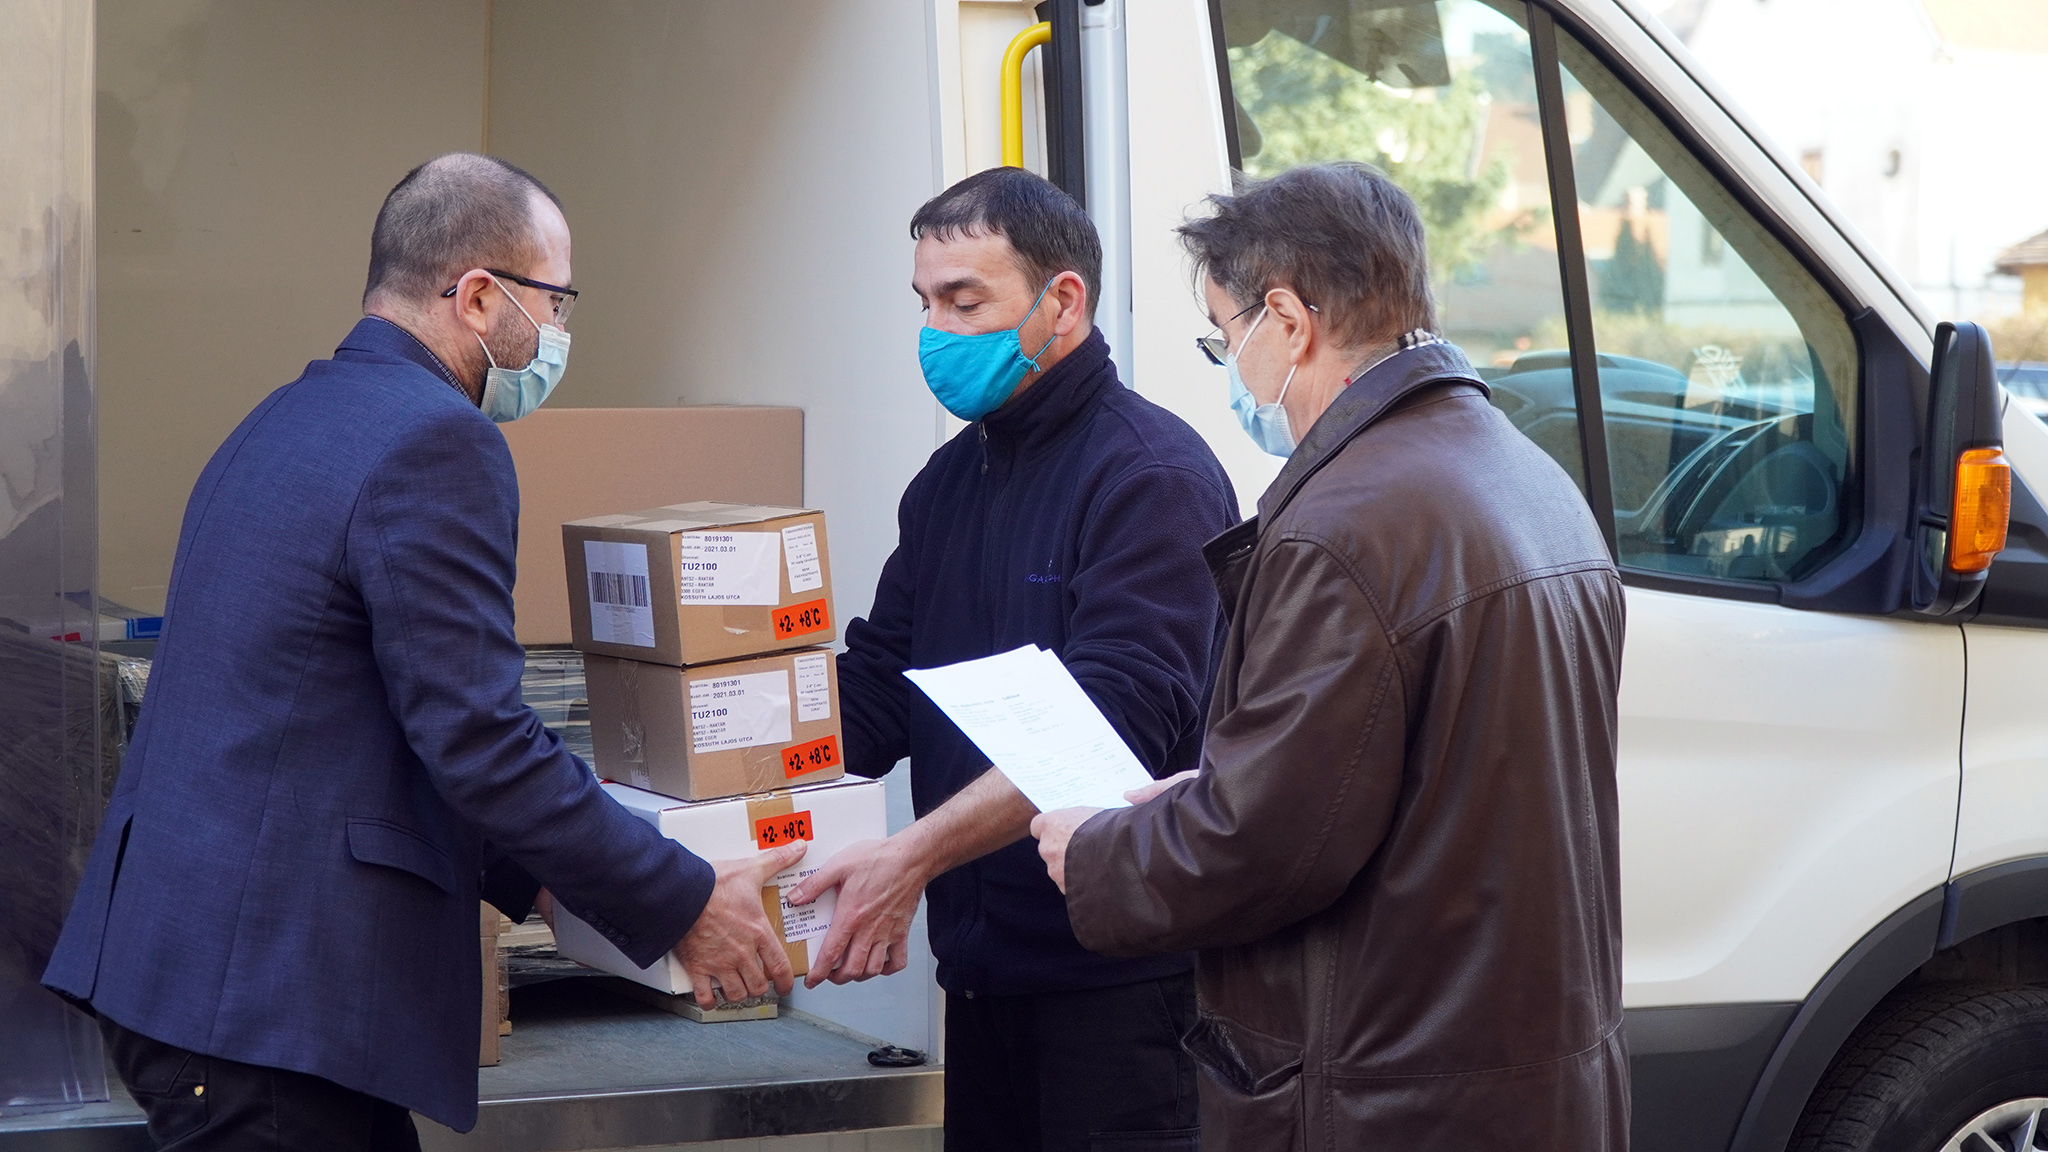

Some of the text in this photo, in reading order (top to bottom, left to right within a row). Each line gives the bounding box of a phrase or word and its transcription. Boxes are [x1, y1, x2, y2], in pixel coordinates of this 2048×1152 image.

[682, 562, 718, 571] TU2100
[712, 679, 741, 689] 80191301
[713, 689, 745, 699] 2021.03.01
[692, 708, 728, 720] TU2100
[694, 741, 720, 749] KOSSUTH
[799, 868, 820, 878] 80191
[785, 930, 810, 938] KOSSUTH
